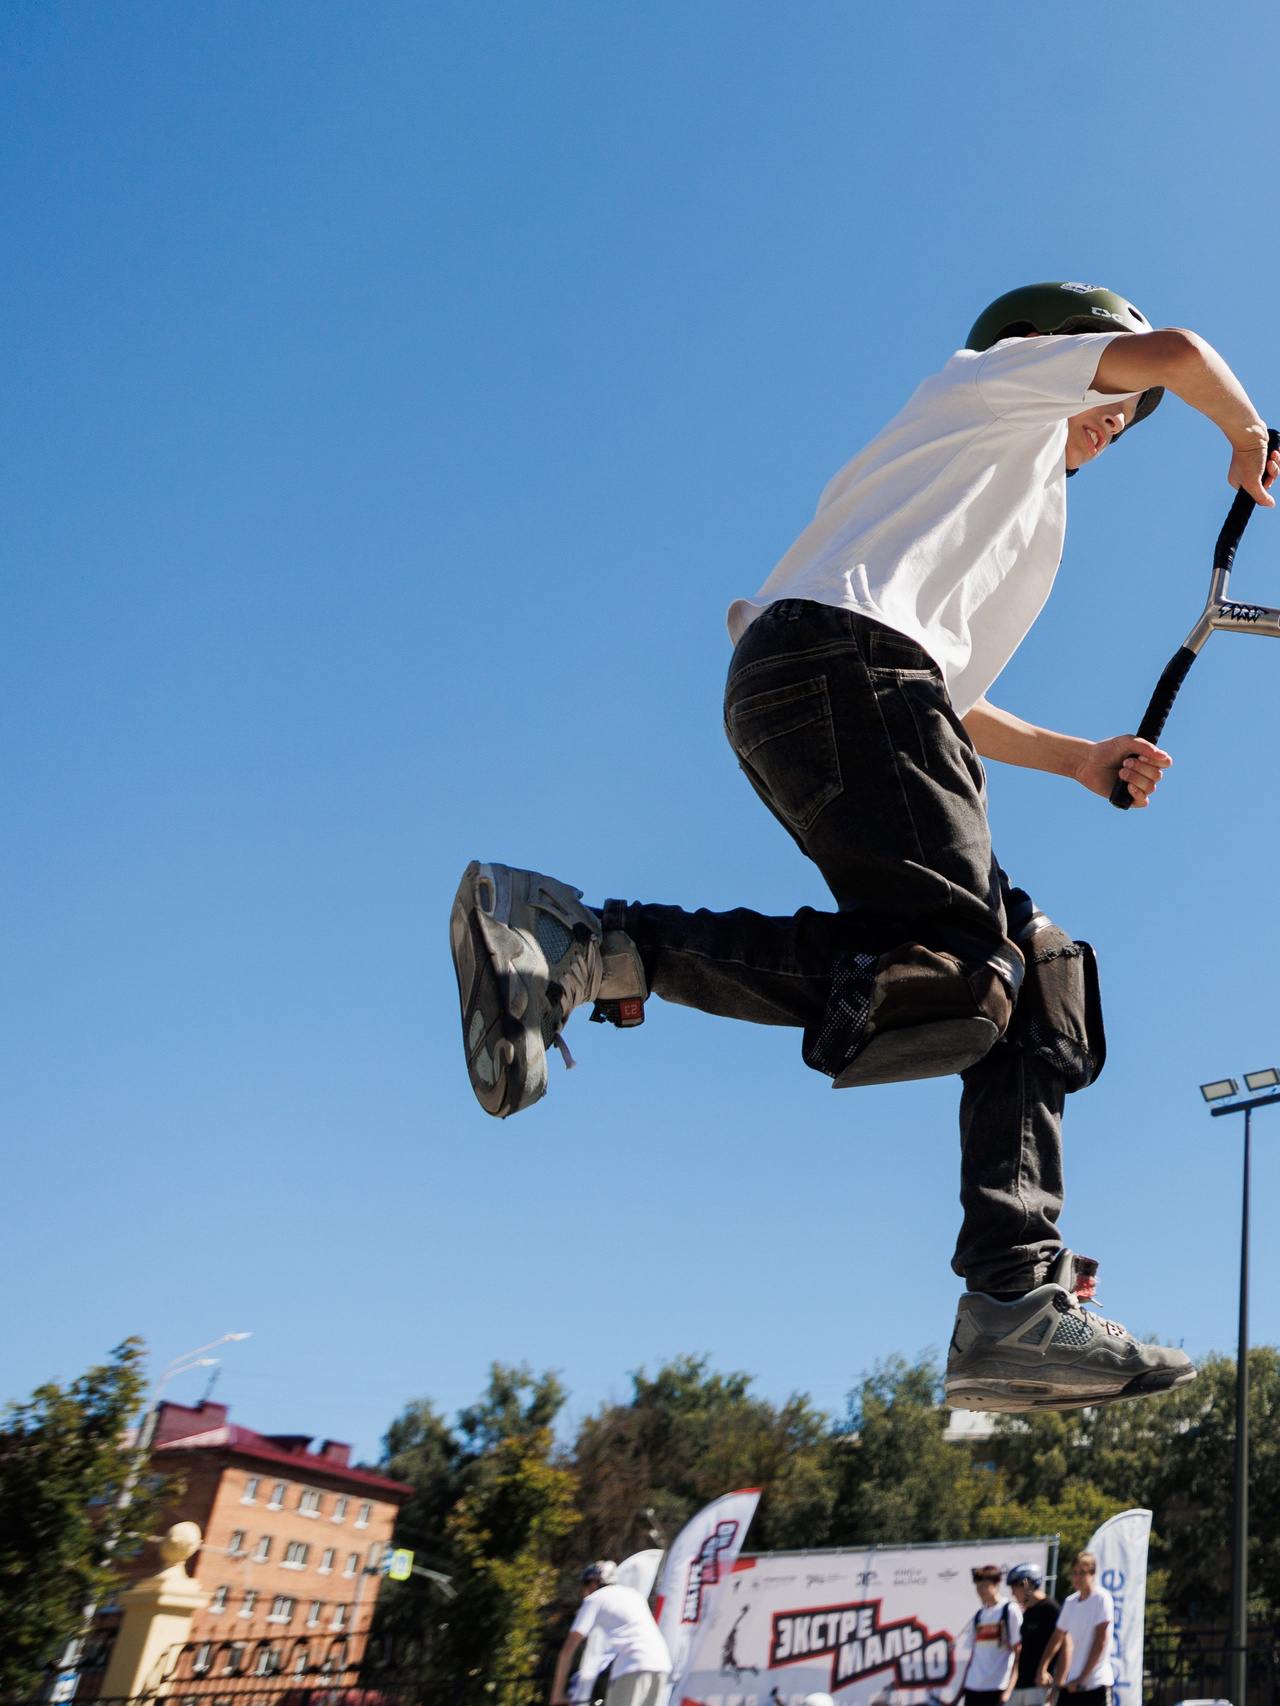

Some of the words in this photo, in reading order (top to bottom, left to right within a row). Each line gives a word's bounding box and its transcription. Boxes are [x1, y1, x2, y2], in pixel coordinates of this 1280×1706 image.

[624, 1004, 638, 1015] 23
[775, 1607, 874, 1660] ЭКСТРЕ
[837, 1625, 923, 1681] МАЛЬ
[900, 1639, 948, 1682] НО
